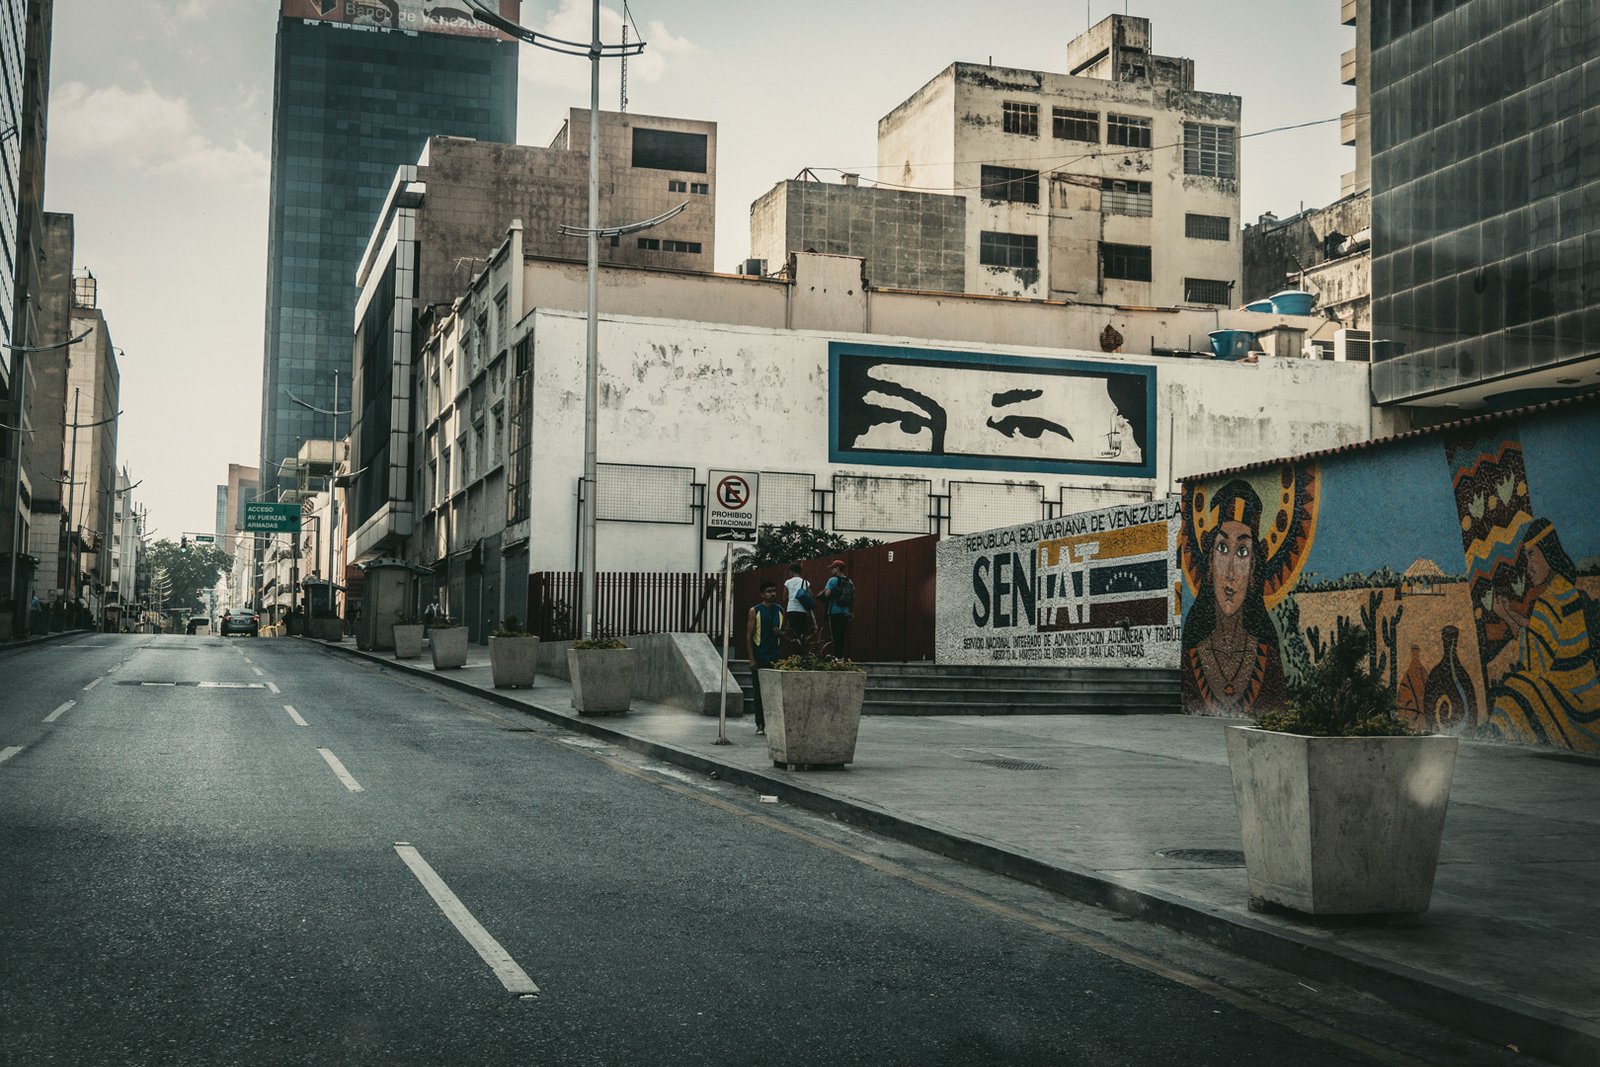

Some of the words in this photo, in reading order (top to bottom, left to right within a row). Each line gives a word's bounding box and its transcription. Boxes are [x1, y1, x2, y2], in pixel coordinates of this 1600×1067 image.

[345, 3, 393, 19] Banco
[398, 9, 416, 22] de
[422, 13, 499, 31] Venezuela
[725, 482, 742, 503] E
[711, 510, 753, 519] PROHIBIDO
[711, 519, 753, 527] ESTACIONAR
[966, 531, 1017, 552] REPUBLICA
[1020, 518, 1088, 543] BOLIVARIANA
[1091, 514, 1105, 532] DE
[1107, 501, 1182, 530] VENEZUELA
[972, 542, 1100, 628] SENIAT
[1012, 634, 1042, 648] INTEGRADO
[1044, 633, 1051, 647] DE
[1054, 631, 1105, 646] ADMINISTRACION
[1108, 628, 1145, 644] ADUANERA
[1146, 628, 1152, 641] Y
[1103, 644, 1115, 658] LAS
[1116, 643, 1145, 658] FINANZAS
